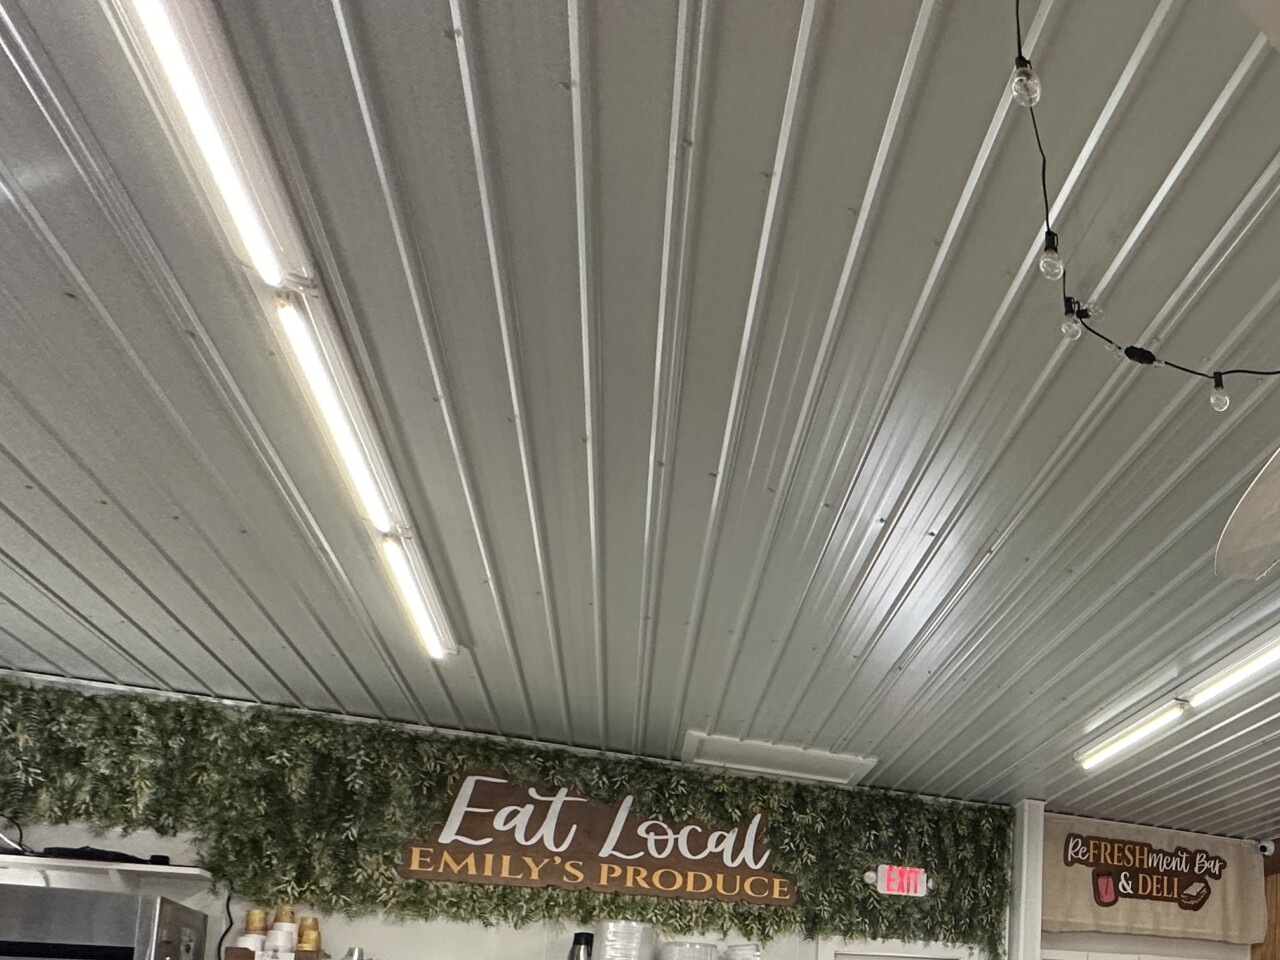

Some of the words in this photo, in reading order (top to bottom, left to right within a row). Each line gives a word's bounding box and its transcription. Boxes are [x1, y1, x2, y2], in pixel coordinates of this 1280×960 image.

[437, 774, 588, 853] Eat
[598, 794, 771, 870] Local
[408, 846, 586, 885] EMILY'S
[599, 863, 792, 901] PRODUCE
[1194, 850, 1224, 876] Bar
[886, 865, 923, 894] EXIT
[1118, 873, 1134, 895] &
[1137, 873, 1180, 899] DELI
